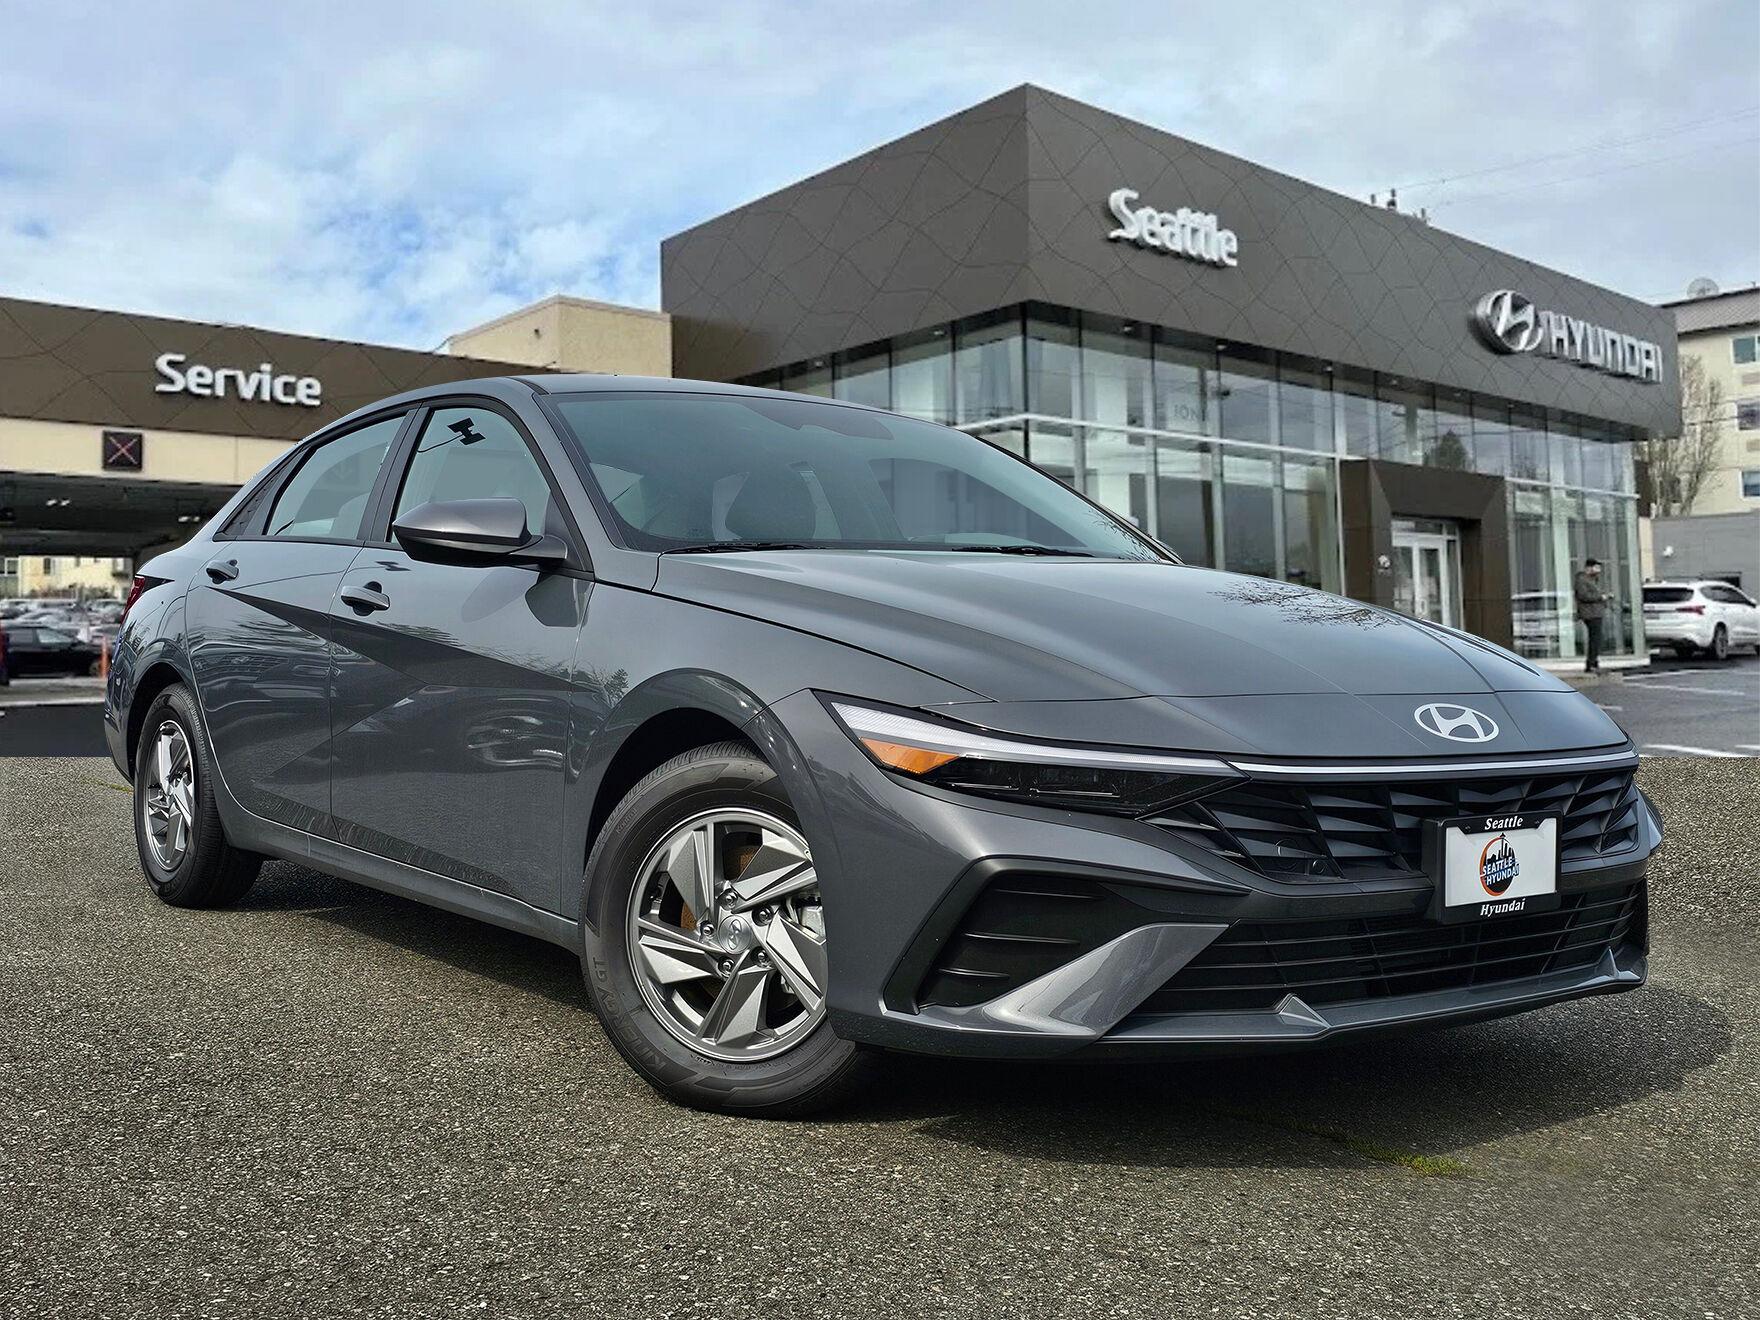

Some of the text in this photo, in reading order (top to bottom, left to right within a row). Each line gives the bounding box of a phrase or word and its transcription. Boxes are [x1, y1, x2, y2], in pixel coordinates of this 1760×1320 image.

[1107, 187, 1238, 267] Seattle
[1540, 311, 1663, 383] HYUNDAI
[154, 353, 322, 406] Service
[1484, 815, 1524, 831] Seattle
[1482, 857, 1514, 877] SEATTLE
[1486, 863, 1520, 886] HYUNDAI
[1480, 898, 1526, 918] Hyundai
